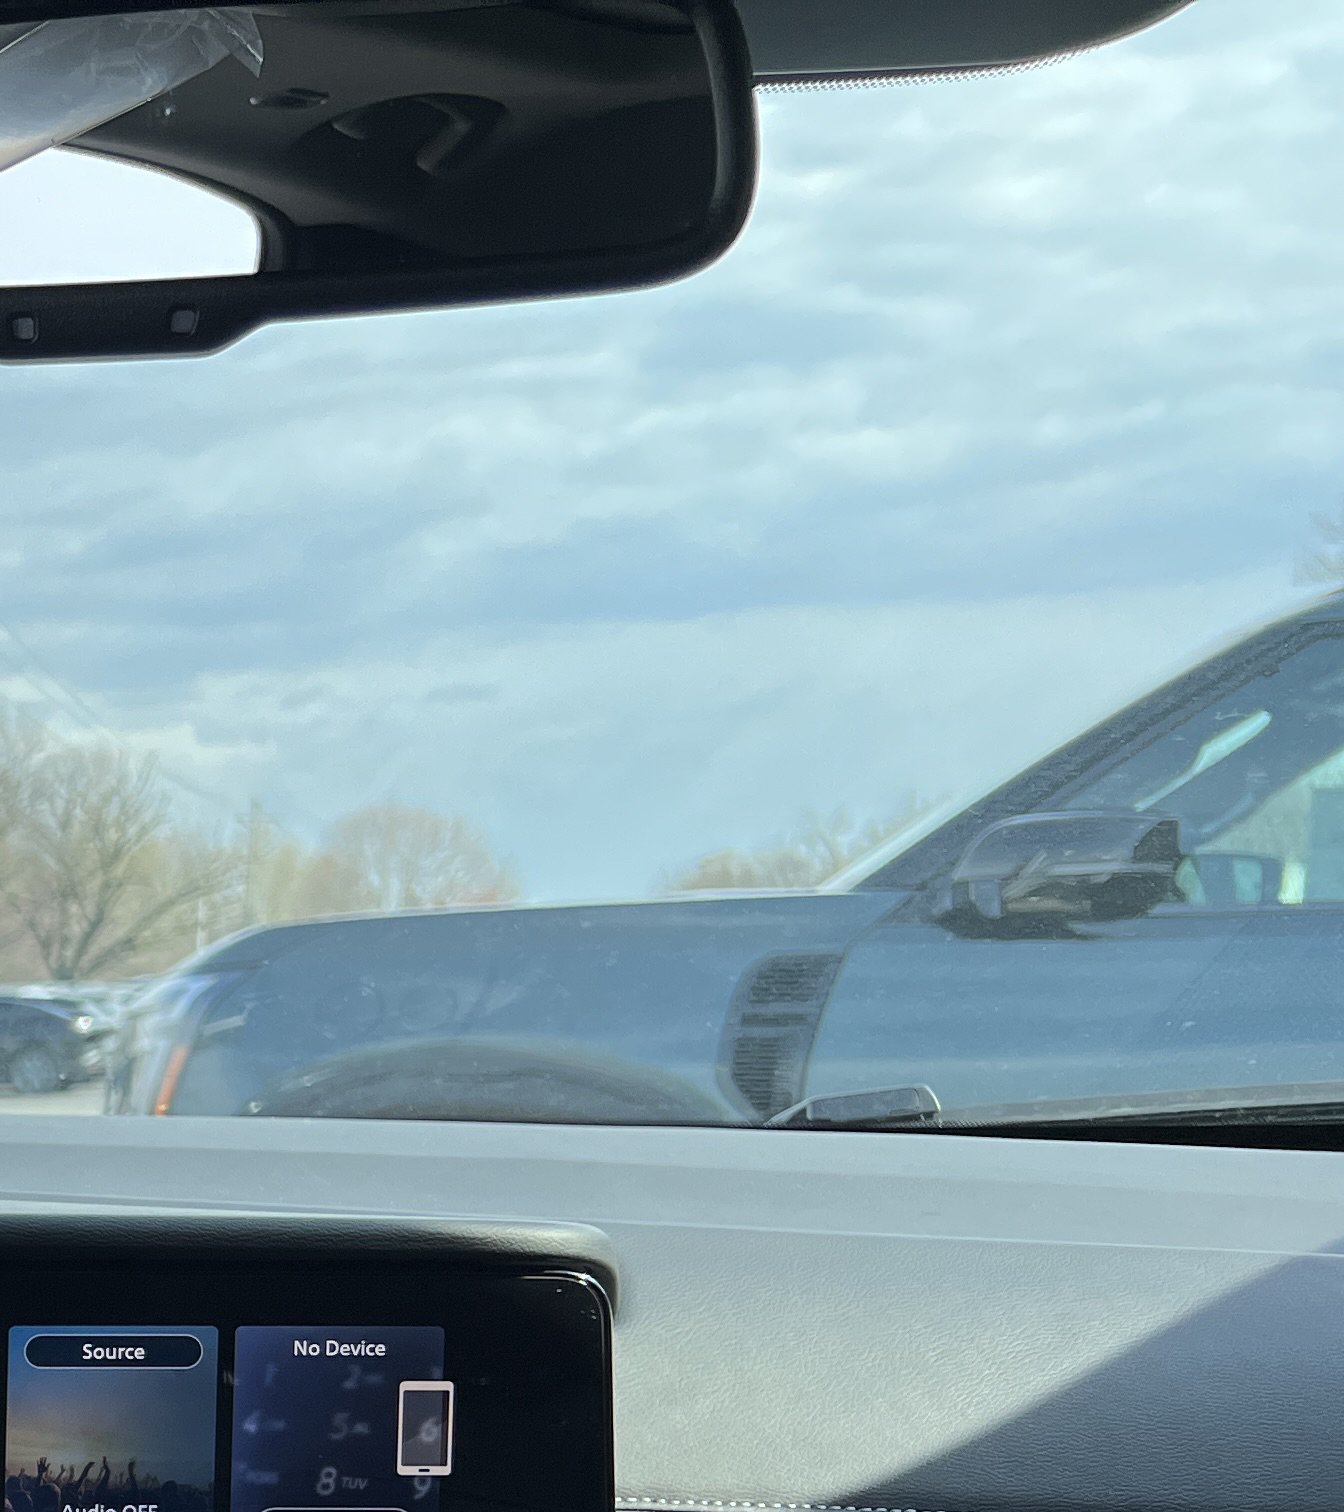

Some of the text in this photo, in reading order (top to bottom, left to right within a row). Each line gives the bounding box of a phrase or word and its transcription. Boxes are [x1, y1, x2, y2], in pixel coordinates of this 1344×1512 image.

[82, 1343, 146, 1360] Source
[293, 1339, 386, 1357] No Device
[316, 1466, 369, 1497] 8 TUV
